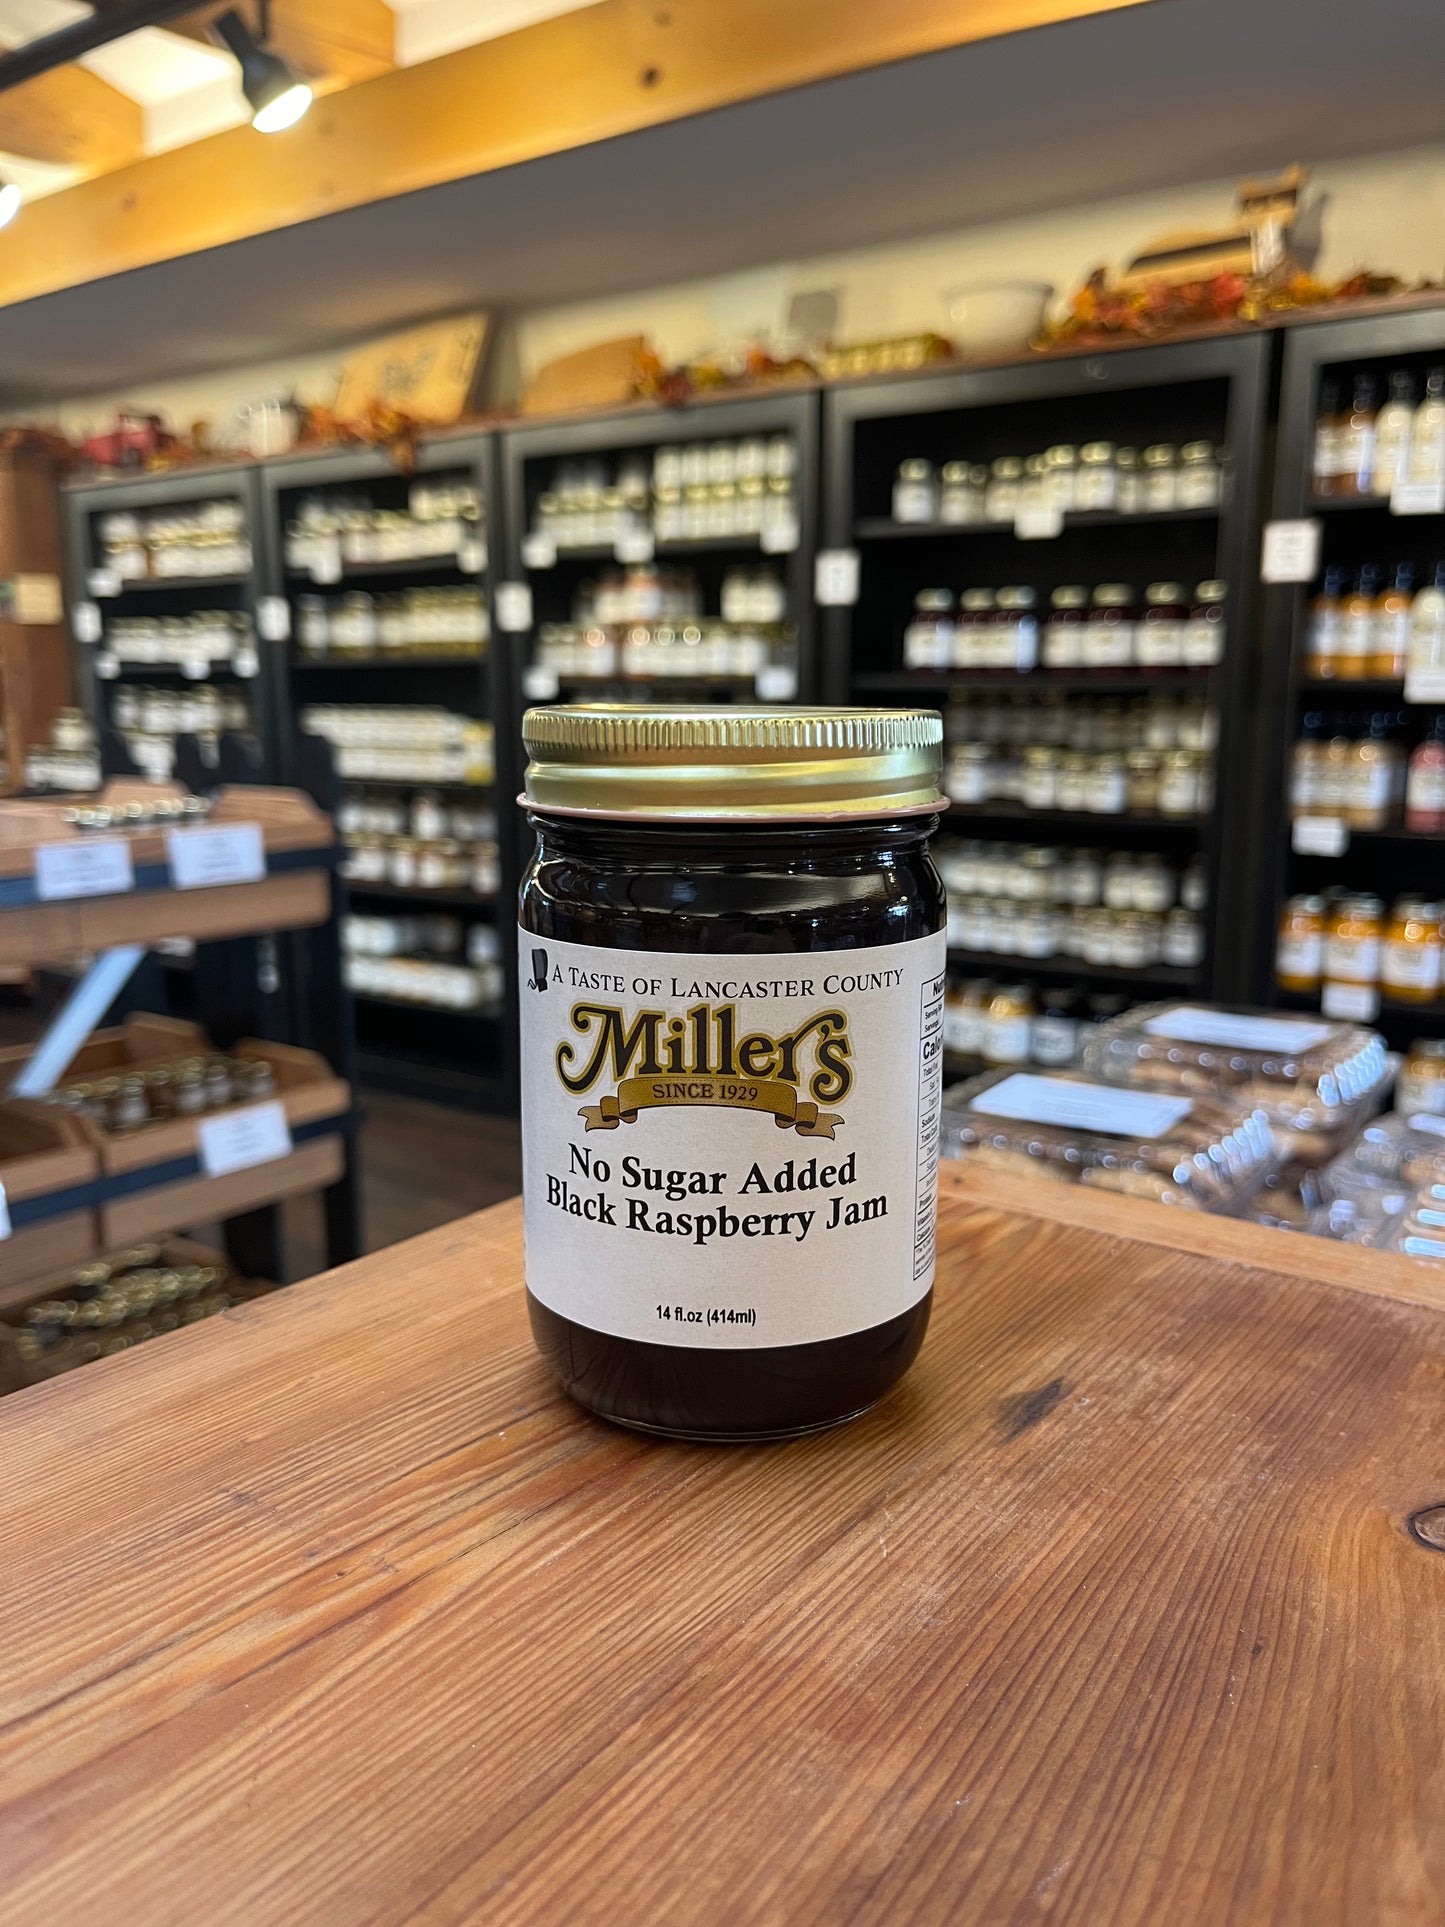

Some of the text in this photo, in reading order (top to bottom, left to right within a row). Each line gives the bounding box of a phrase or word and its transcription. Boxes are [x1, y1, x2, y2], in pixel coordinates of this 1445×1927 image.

[552, 963, 905, 999] A TASTE OF LANCASTER COUNTY
[555, 1002, 854, 1106] Miller's
[653, 1083, 759, 1103] SINCE 1929
[568, 1143, 858, 1202] No Sugar Added
[546, 1172, 888, 1246] Black Raspberry Jam
[656, 1304, 757, 1328] 14 fl.oz (414ml)
